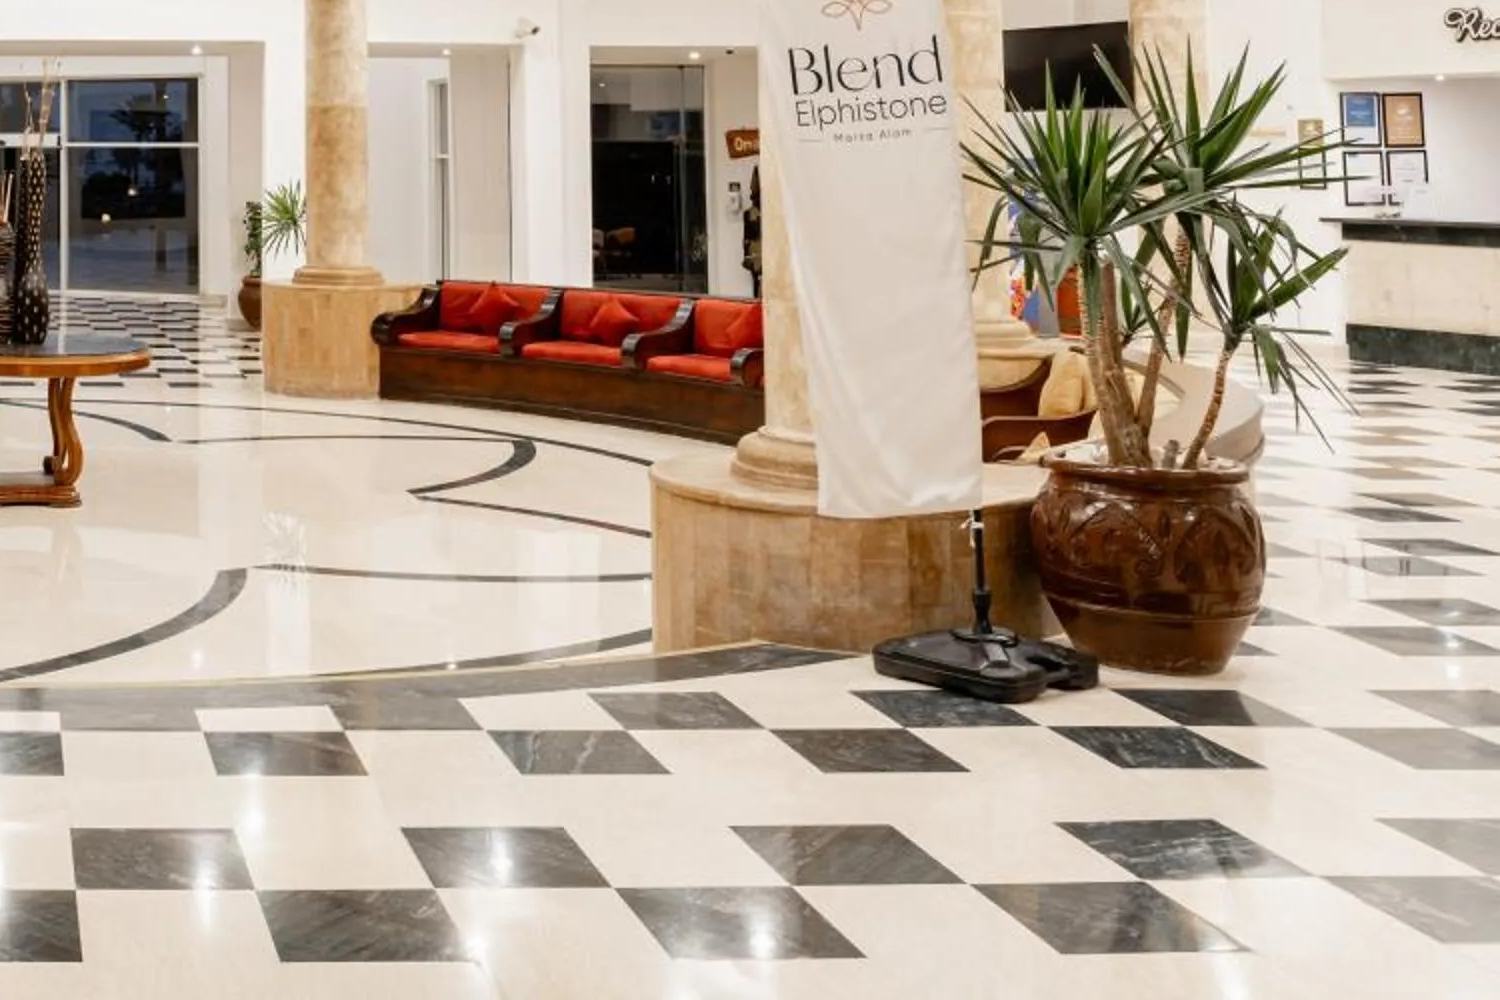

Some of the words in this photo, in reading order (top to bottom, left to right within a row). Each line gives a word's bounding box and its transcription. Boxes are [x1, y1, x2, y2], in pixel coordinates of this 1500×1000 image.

[787, 34, 943, 96] Blend
[795, 95, 947, 131] Elphistone
[879, 129, 912, 140] Alam
